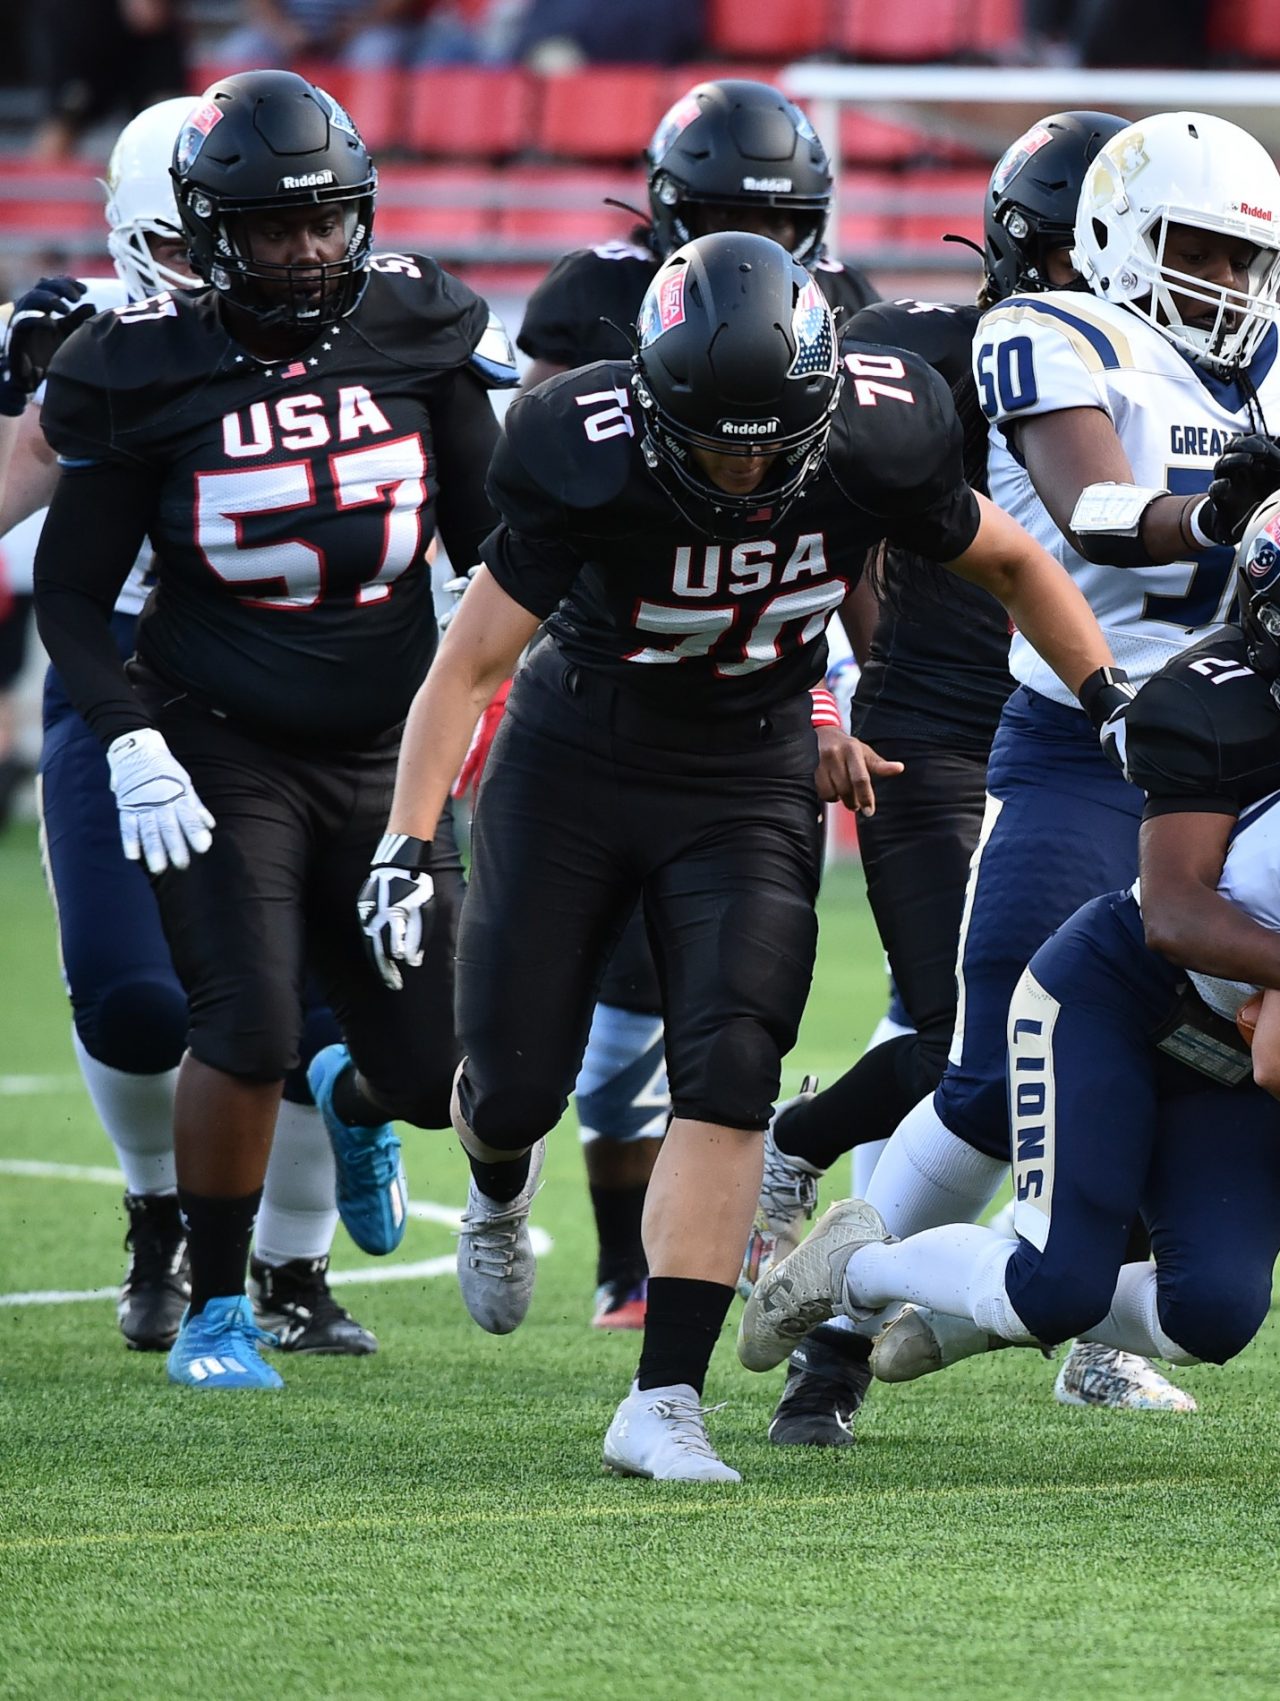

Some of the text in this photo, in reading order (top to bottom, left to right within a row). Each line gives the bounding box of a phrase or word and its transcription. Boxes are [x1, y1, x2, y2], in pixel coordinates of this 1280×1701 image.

[283, 169, 333, 188] Riddell
[743, 177, 793, 192] Riddell
[1240, 203, 1272, 222] Riddell
[844, 353, 916, 407] 70
[977, 336, 1038, 422] 50
[222, 385, 394, 459] USA
[721, 421, 777, 435] Riddell
[193, 432, 428, 612] 57
[672, 532, 828, 597] USA
[620, 577, 849, 680] 70
[1188, 657, 1255, 686] 21
[1013, 1018, 1046, 1202] LIONS
